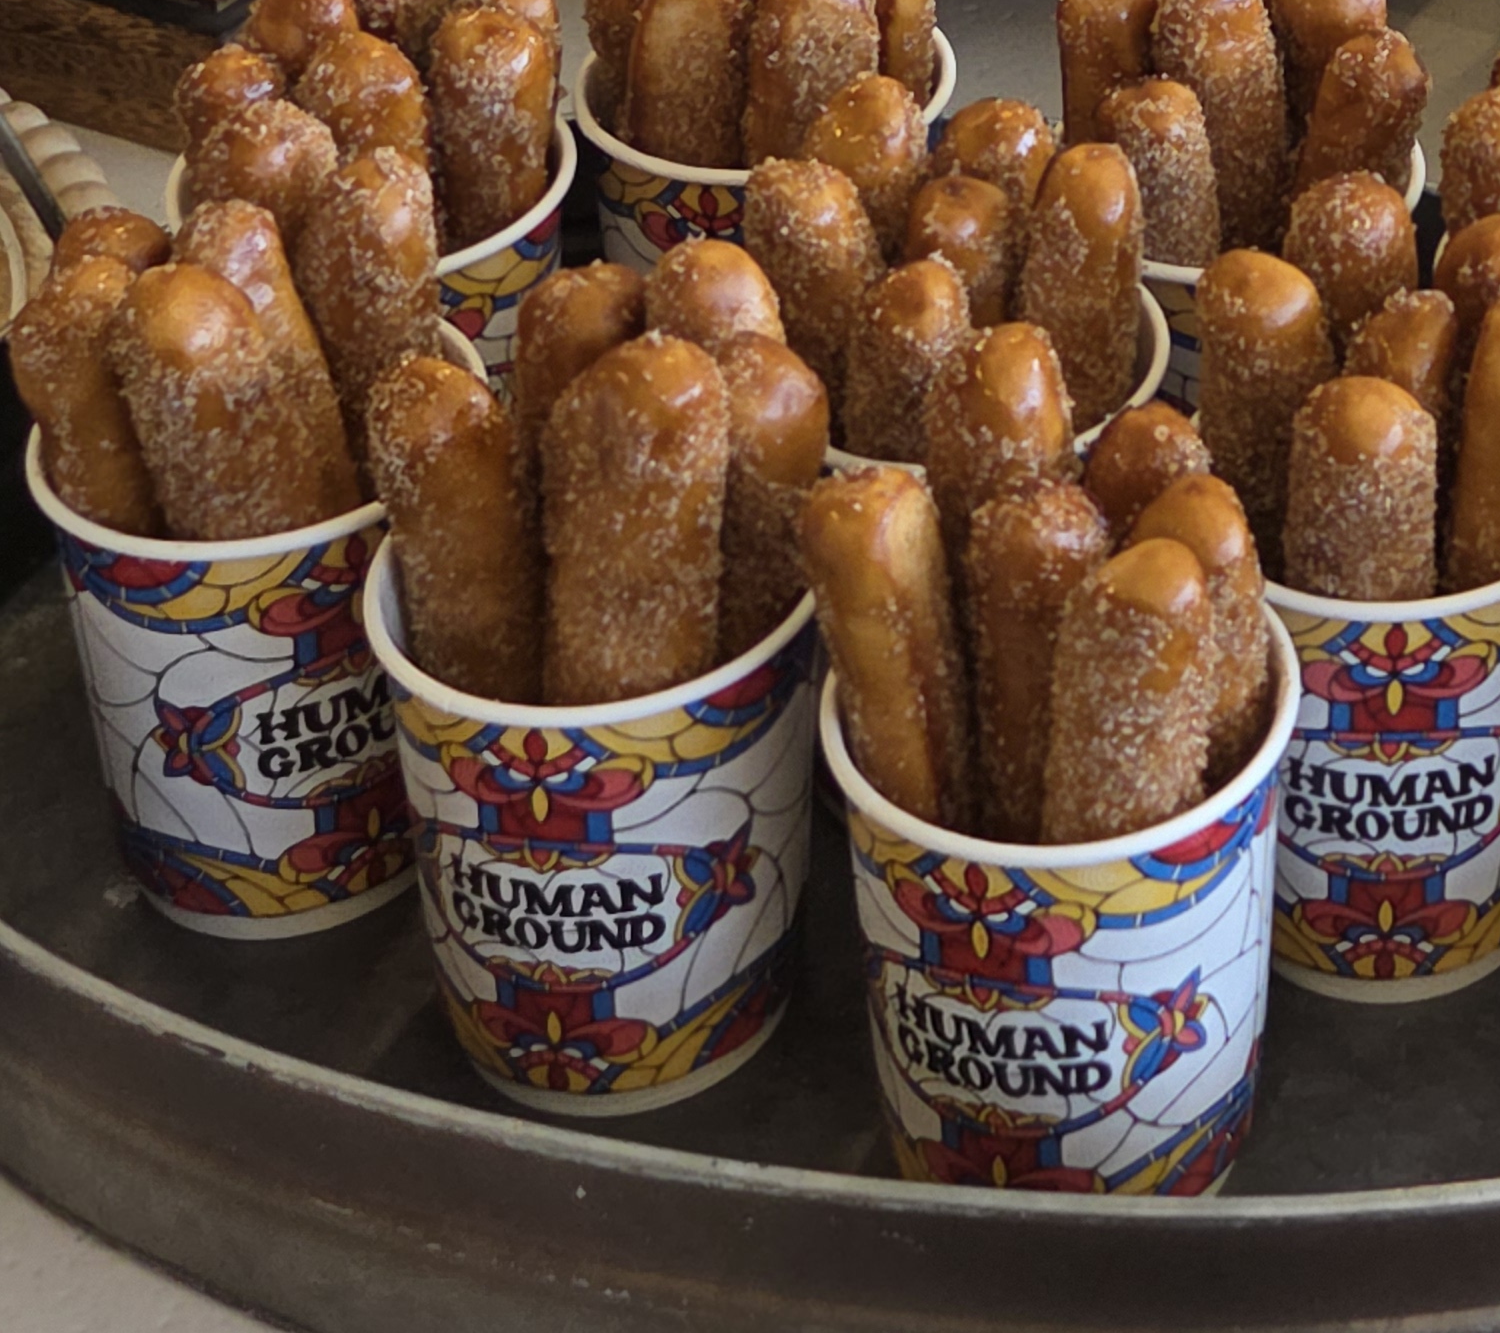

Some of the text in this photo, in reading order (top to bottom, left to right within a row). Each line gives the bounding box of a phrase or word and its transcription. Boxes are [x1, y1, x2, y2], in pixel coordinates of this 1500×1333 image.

[256, 670, 394, 745] HUM
[257, 710, 397, 779] GROU
[1288, 754, 1496, 807] HUMAN
[1284, 794, 1494, 842] GROUND
[451, 852, 664, 917] HUMAN
[452, 891, 667, 953] GROUND
[895, 981, 1109, 1060] HUMAN
[897, 1023, 1112, 1097] GROUND
